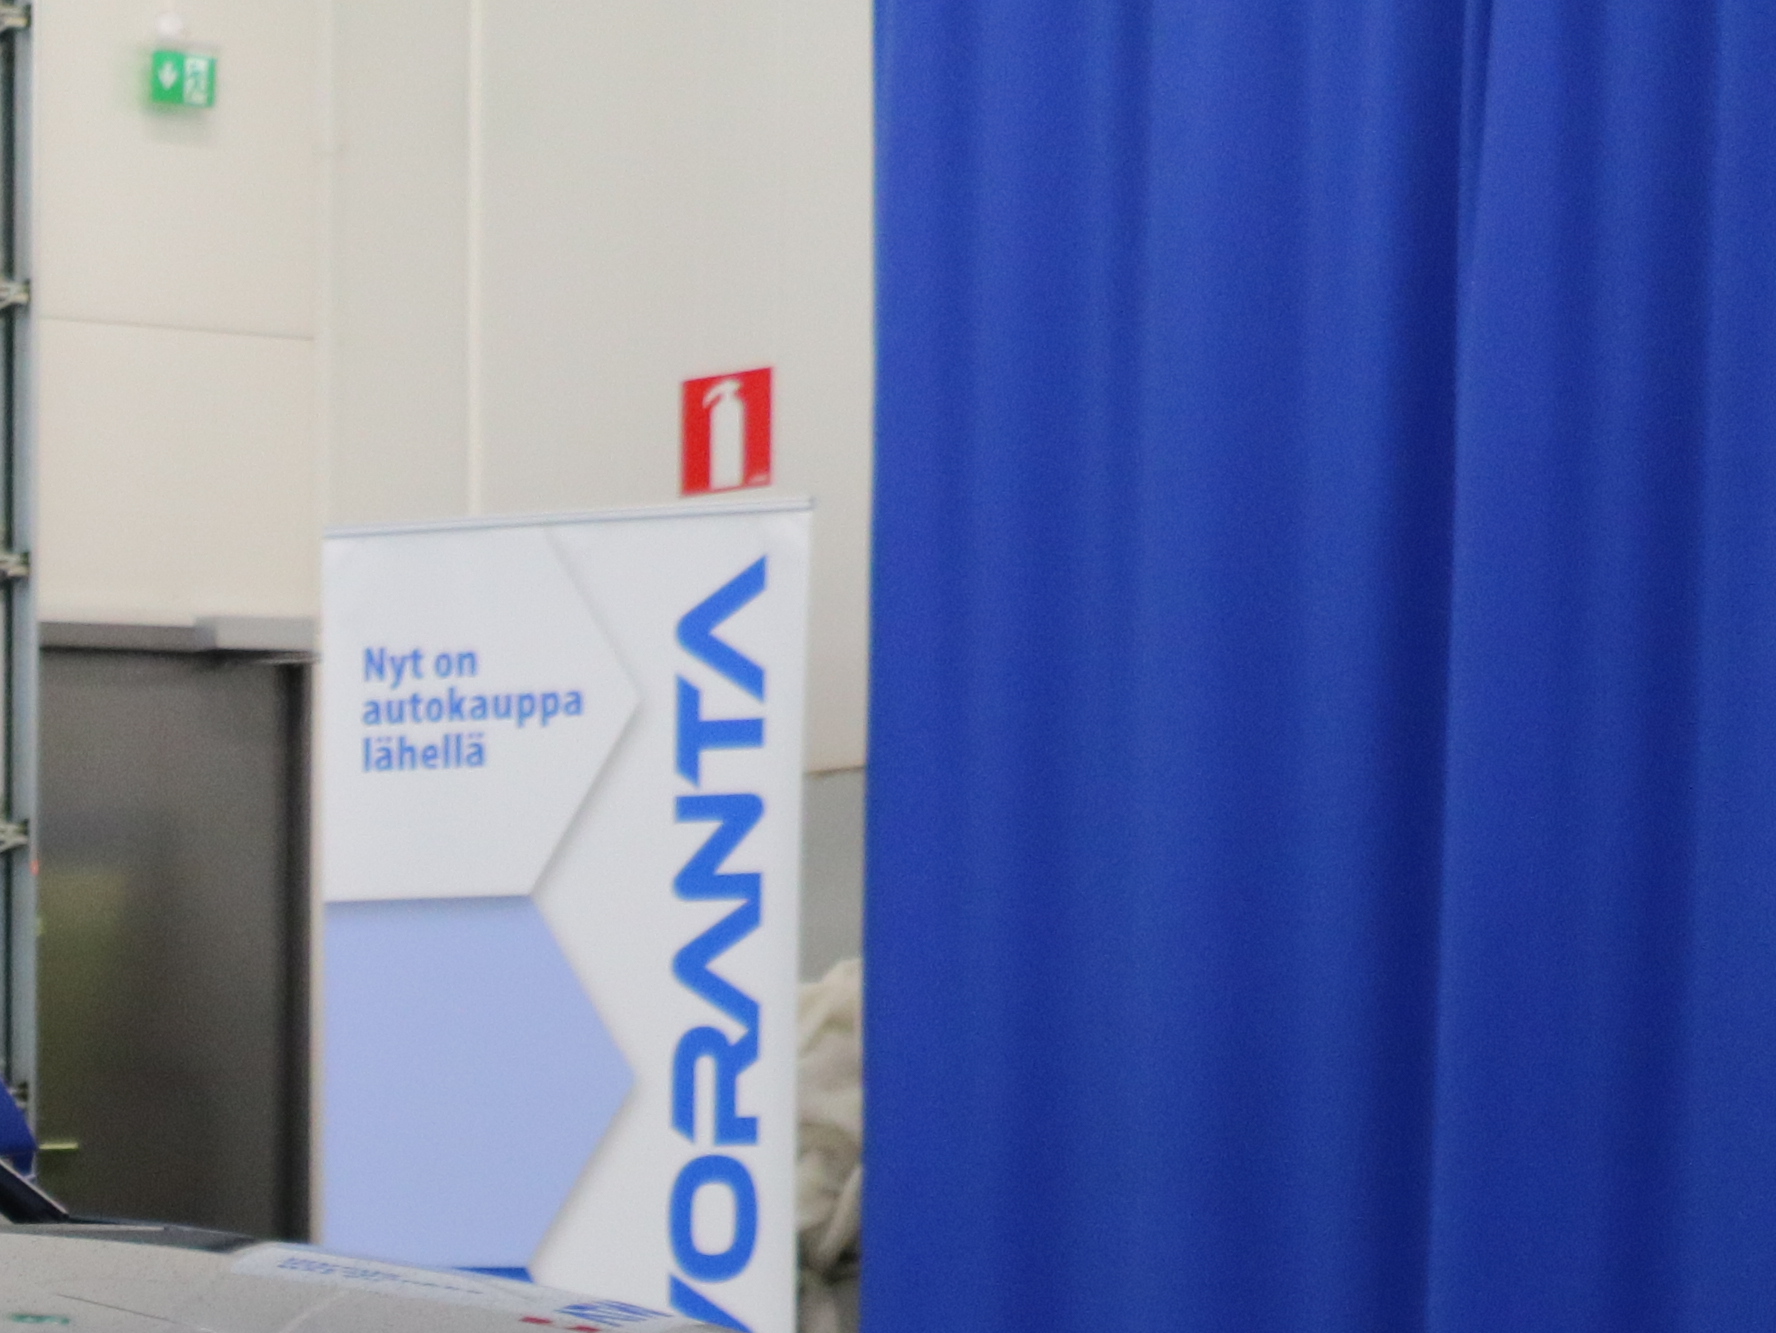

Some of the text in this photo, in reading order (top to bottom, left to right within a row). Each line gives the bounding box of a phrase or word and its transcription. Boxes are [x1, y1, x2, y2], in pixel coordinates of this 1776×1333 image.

[362, 645, 479, 684] Nyt on
[362, 688, 584, 728] autokauppa
[362, 734, 486, 772] lähellä
